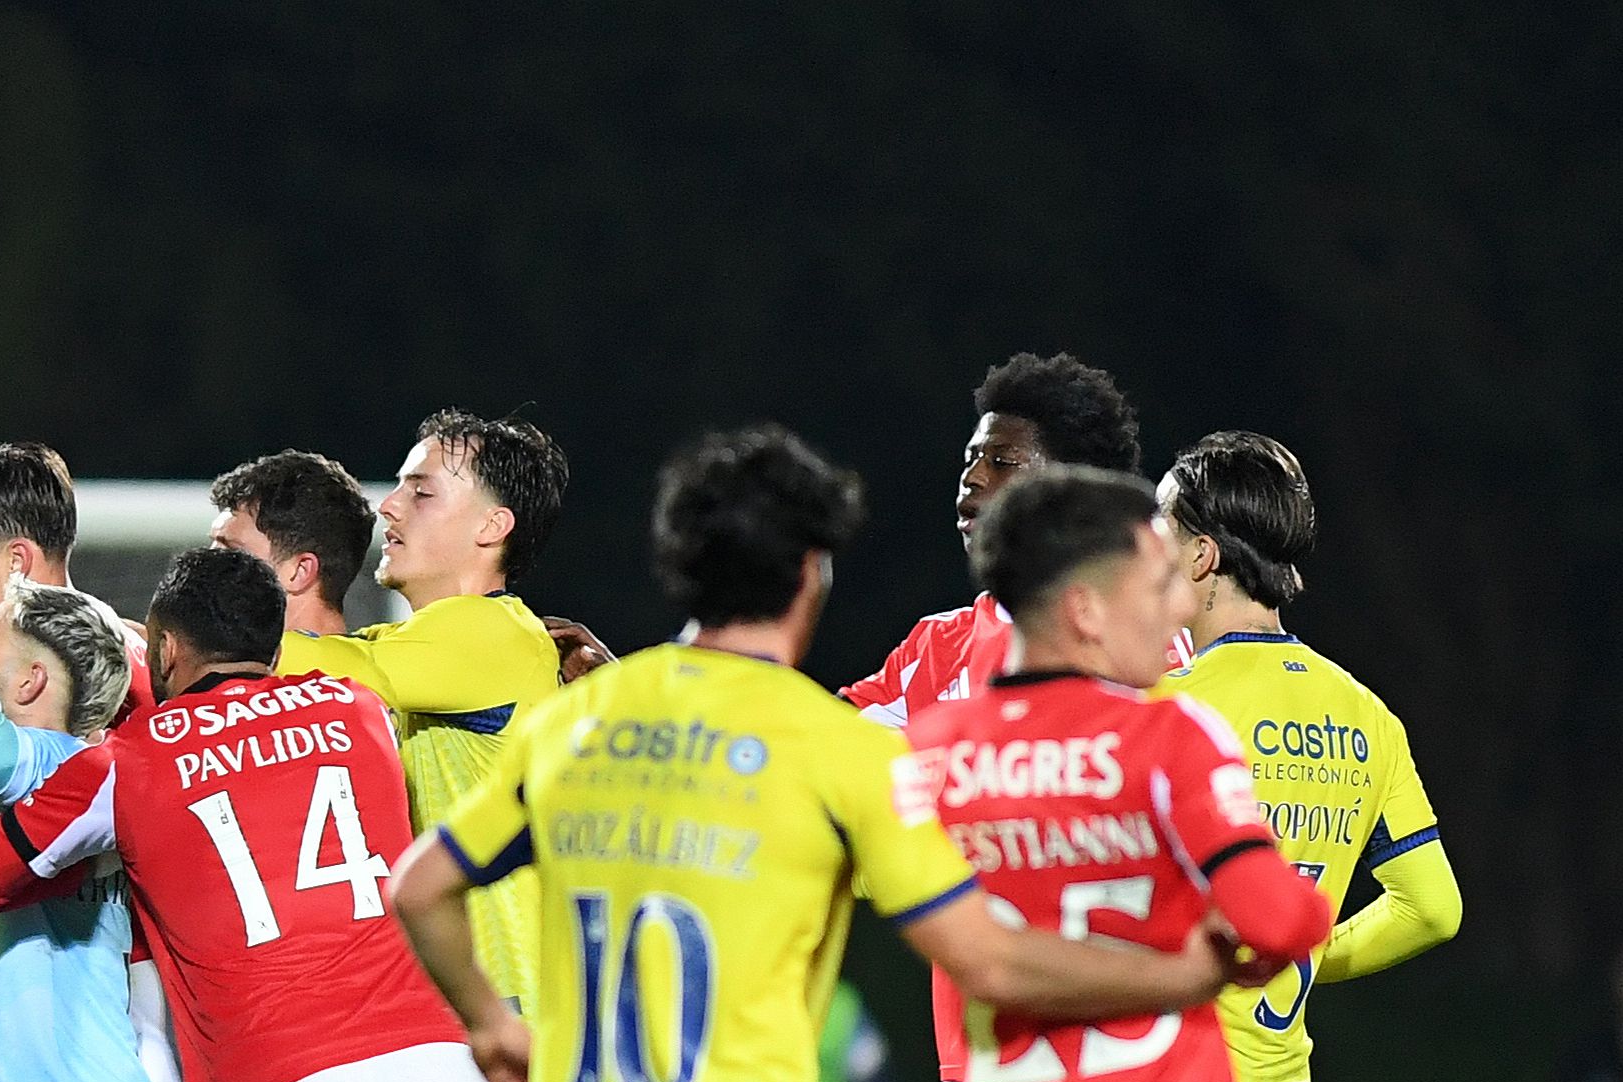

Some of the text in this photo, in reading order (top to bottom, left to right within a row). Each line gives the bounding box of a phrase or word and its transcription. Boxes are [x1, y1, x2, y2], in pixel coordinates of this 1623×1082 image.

[193, 675, 355, 736] SAGRES
[174, 720, 353, 790] PAVLIDIS
[942, 731, 1125, 808] SAGRES
[1253, 713, 1369, 764] castro
[1251, 762, 1373, 789] ELECTRÓNICA
[186, 766, 392, 948] 14
